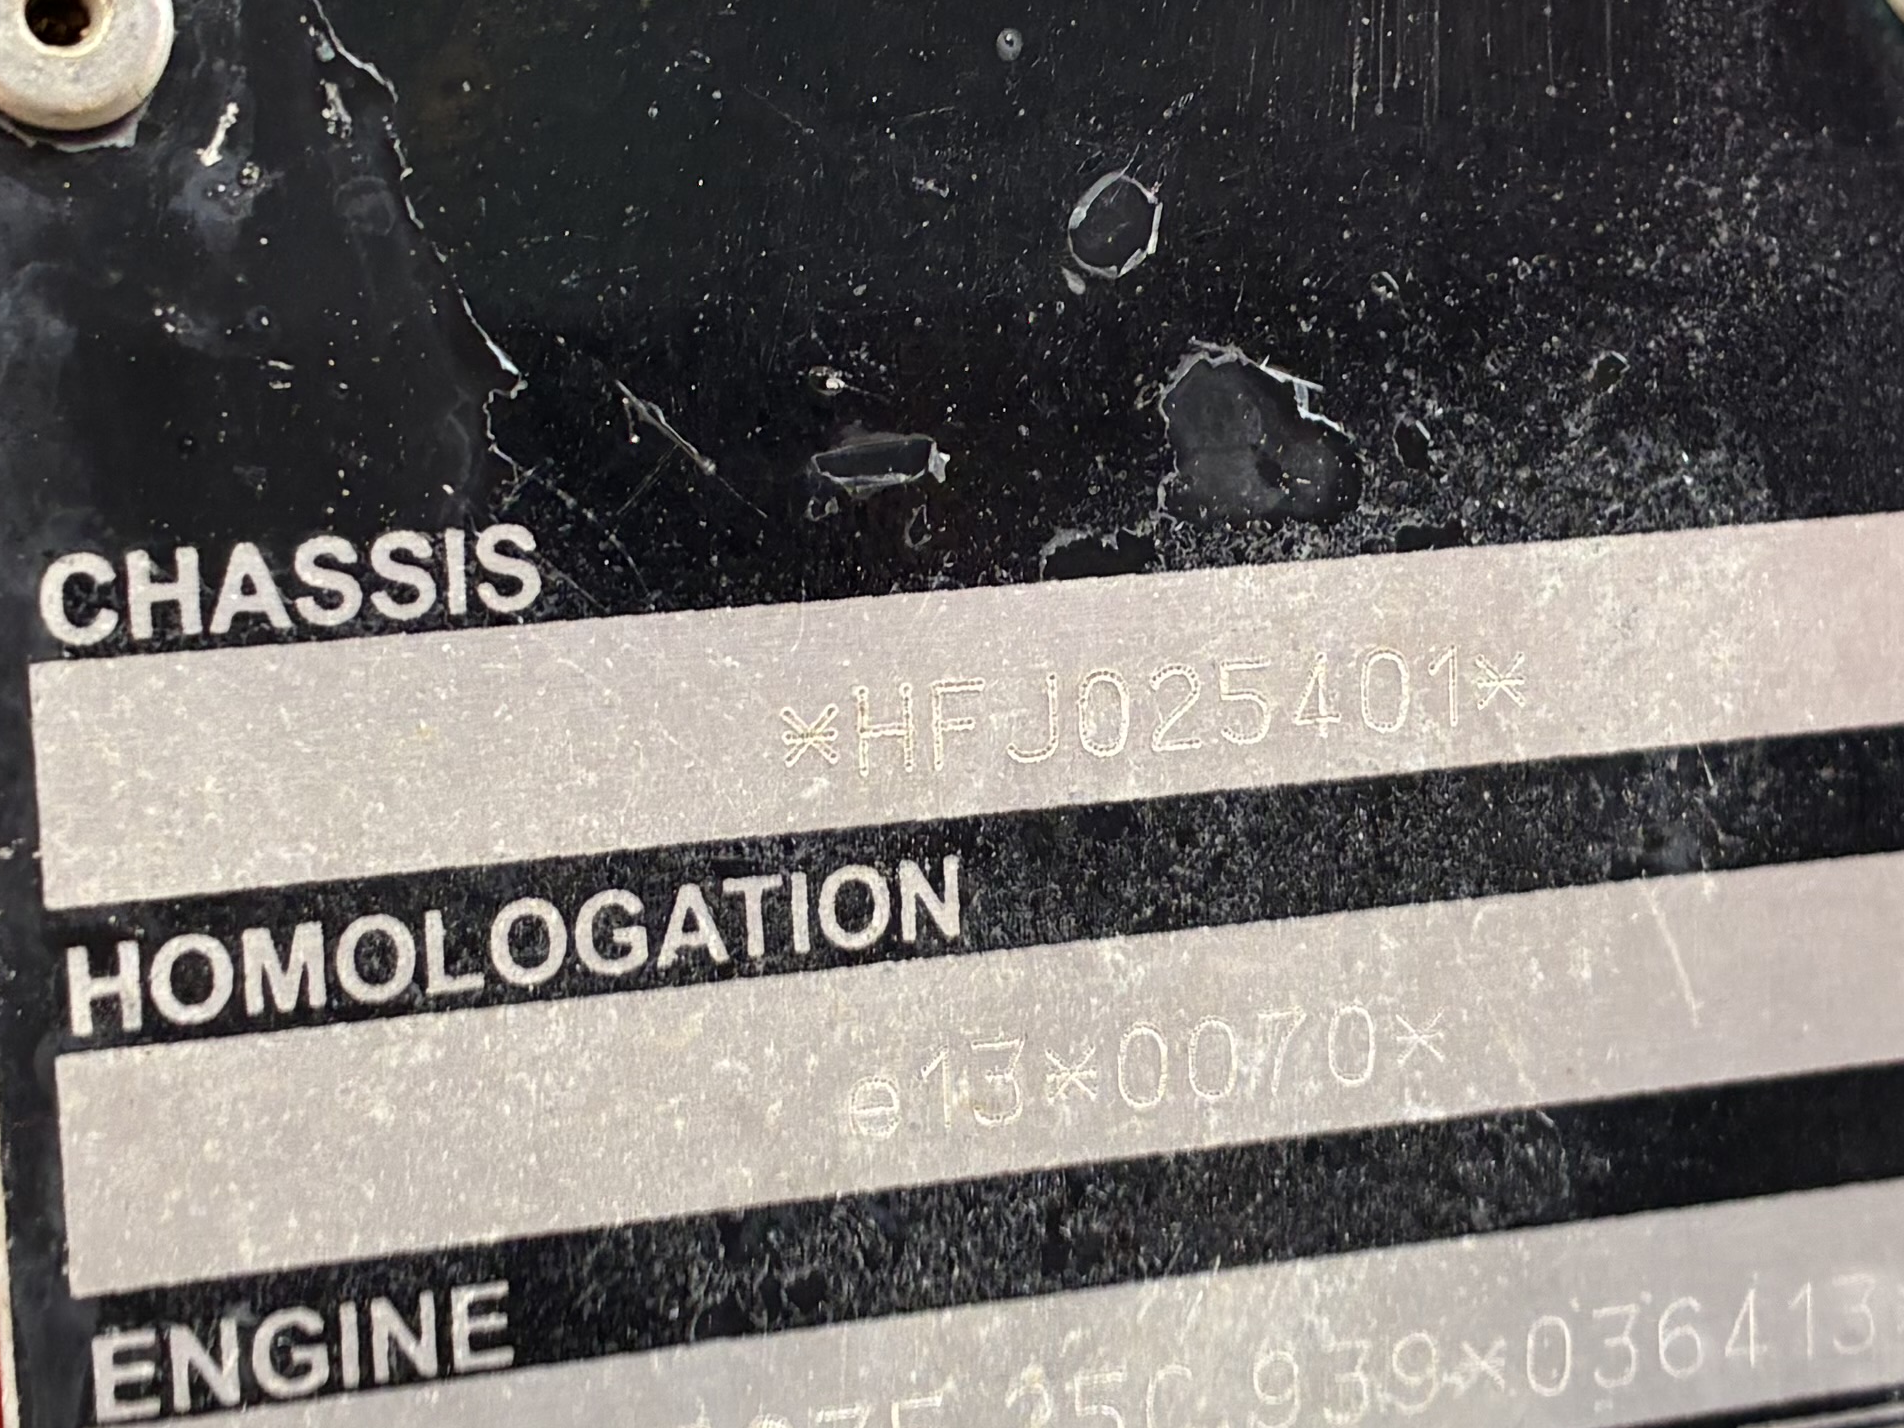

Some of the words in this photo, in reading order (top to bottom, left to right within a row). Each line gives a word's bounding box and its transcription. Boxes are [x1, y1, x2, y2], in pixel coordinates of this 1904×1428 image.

[37, 522, 543, 649] CHASSIS
[63, 855, 964, 1039] HOMOLOGATION
[89, 1281, 513, 1421] ENGINE
